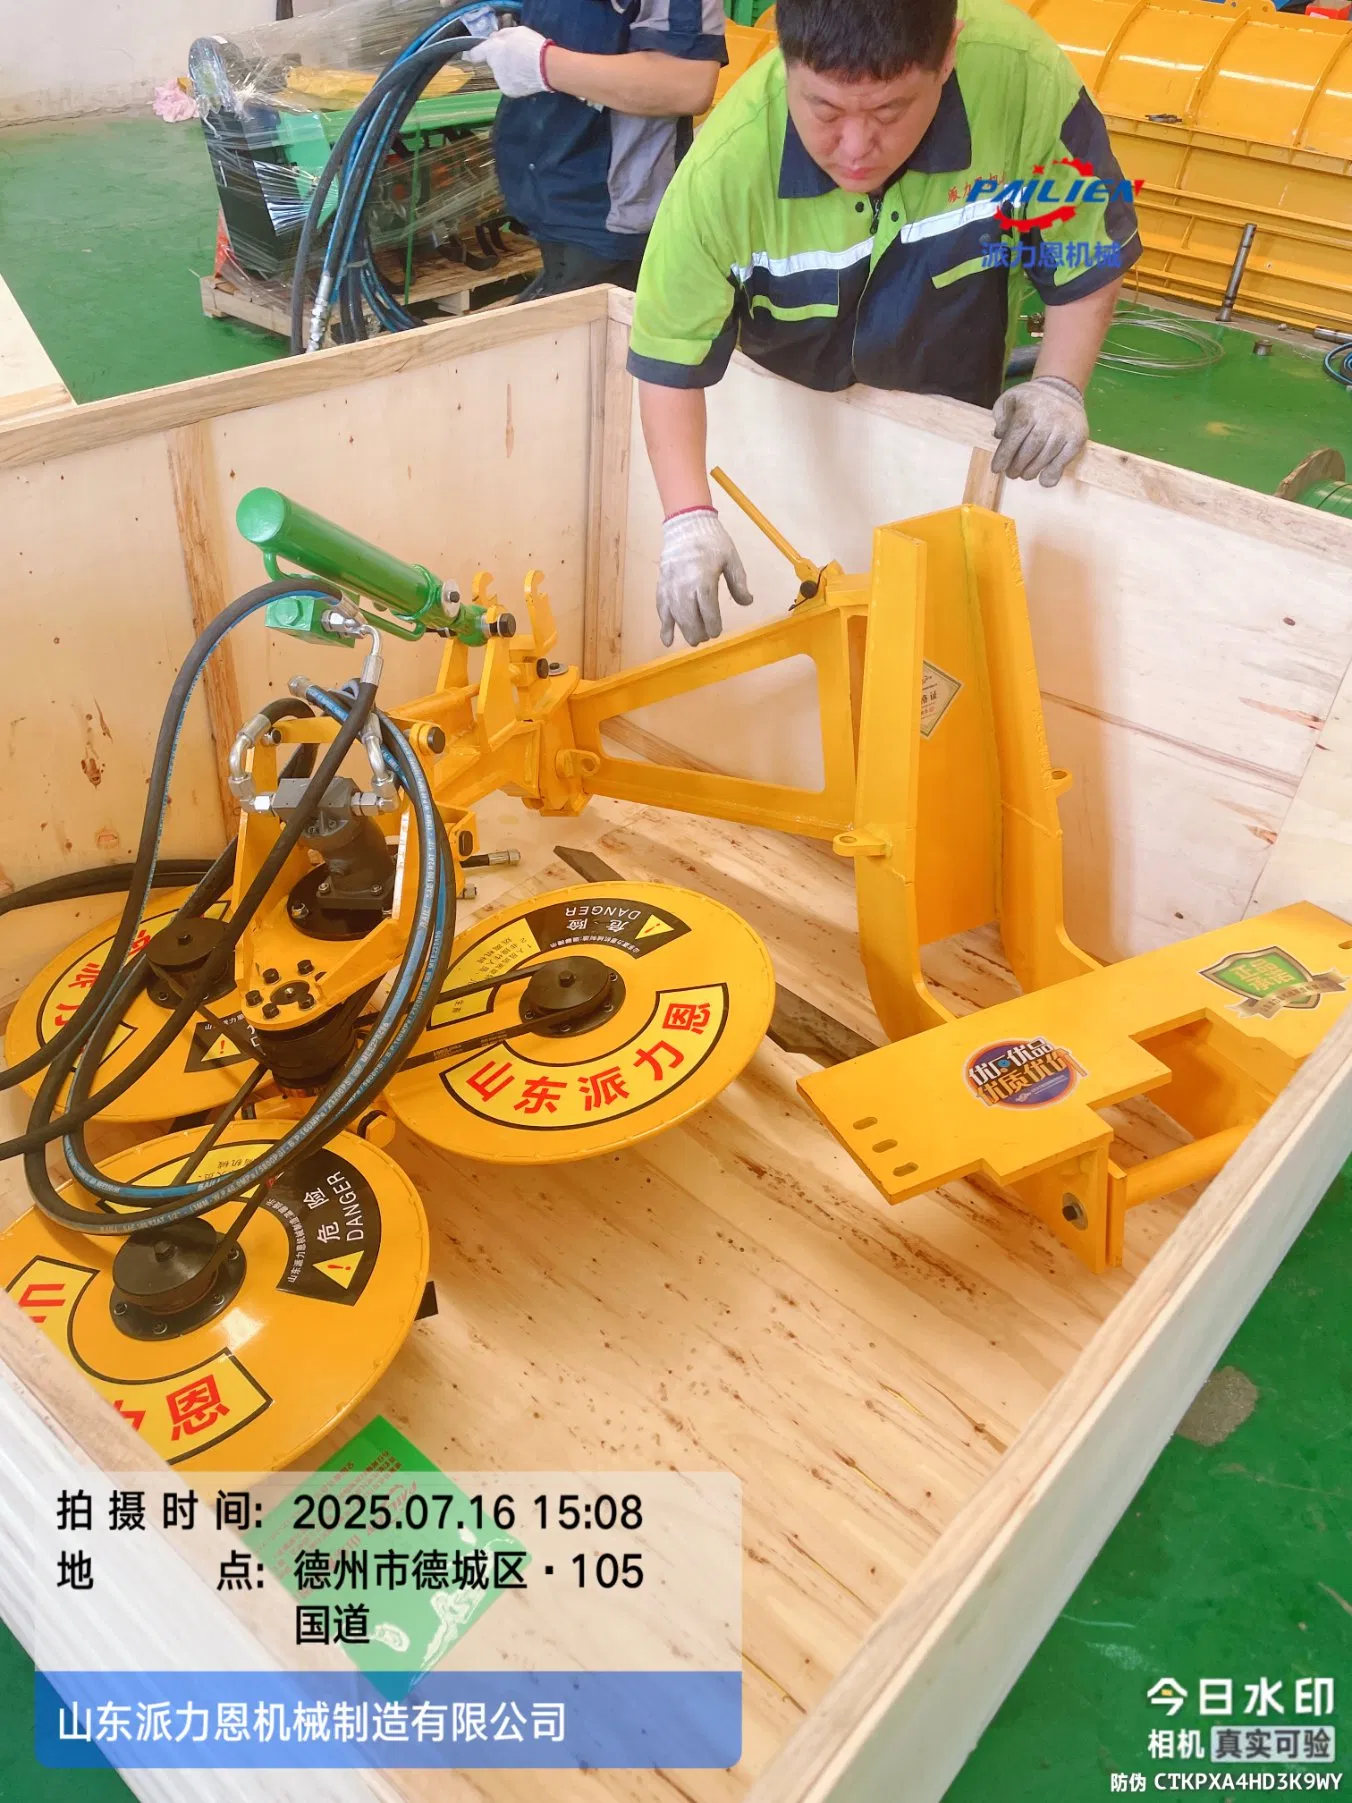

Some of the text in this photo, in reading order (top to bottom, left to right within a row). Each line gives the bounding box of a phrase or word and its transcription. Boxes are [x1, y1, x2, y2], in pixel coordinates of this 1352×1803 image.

[565, 905, 641, 920] DANGER
[466, 1002, 711, 1114] 山东派力恩
[326, 1171, 364, 1241] DANGER
